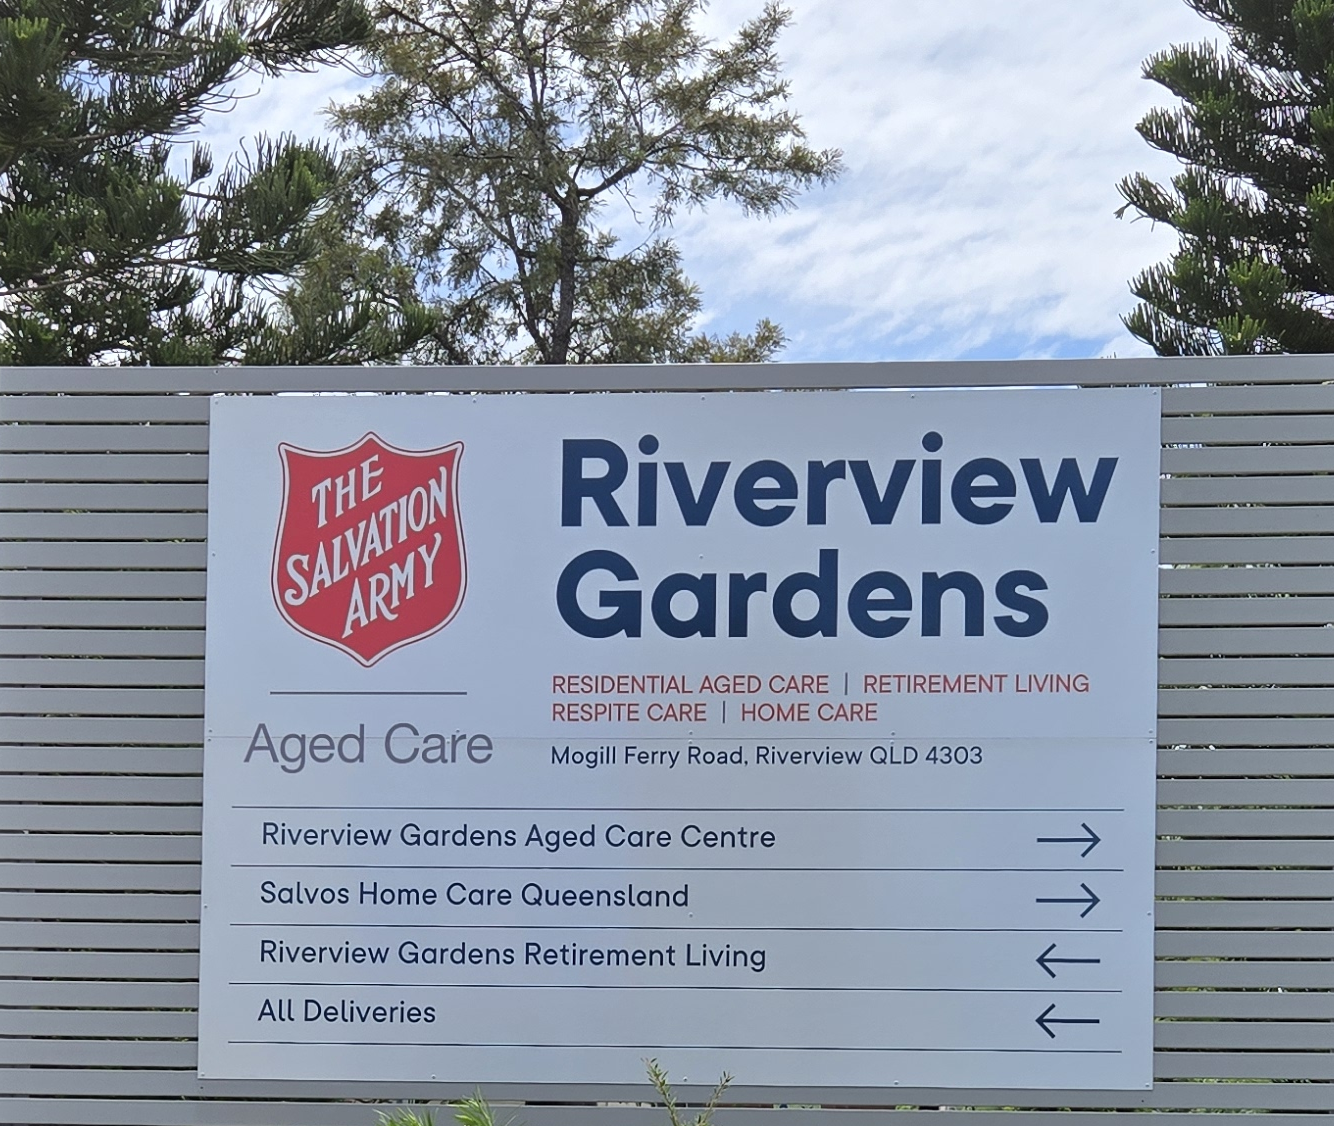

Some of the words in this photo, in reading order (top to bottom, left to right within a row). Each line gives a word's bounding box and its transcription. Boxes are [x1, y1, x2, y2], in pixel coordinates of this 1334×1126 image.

[312, 454, 384, 528] THE
[561, 431, 1119, 527] Riverview
[284, 466, 447, 606] SALVATION
[342, 532, 442, 639] ARMY
[556, 549, 1049, 638] Gardens
[553, 675, 693, 694] RESIDENTIAL
[699, 675, 761, 693] AGED
[769, 675, 829, 693] CARE
[864, 674, 1008, 693] RETIREMENT
[1016, 674, 1089, 692] LIVING
[553, 703, 639, 722] RESPITE
[647, 703, 706, 722] CARE
[742, 703, 810, 722] HOME
[818, 703, 877, 721] CARE
[244, 723, 364, 773] Aged
[385, 723, 493, 764] Care
[552, 746, 615, 769] Mogill
[625, 746, 680, 769] Ferry
[688, 746, 748, 766] Road,
[756, 746, 862, 764] Riverview
[870, 746, 918, 765] QLD
[925, 746, 982, 764] 4303
[263, 822, 392, 846] Riverview
[400, 823, 516, 846] Gardens
[525, 824, 595, 853] Aged
[605, 824, 671, 847] Care
[681, 825, 775, 848] Centre
[261, 881, 349, 904] Salvos
[360, 882, 437, 905] Home
[446, 883, 512, 906] Care
[522, 883, 688, 907] Queensland
[261, 940, 390, 964] Riverview
[398, 941, 514, 965] Gardens
[525, 942, 675, 966] Retirement
[687, 944, 765, 972] Living
[258, 999, 295, 1022] All
[304, 999, 435, 1023] Deliveries
